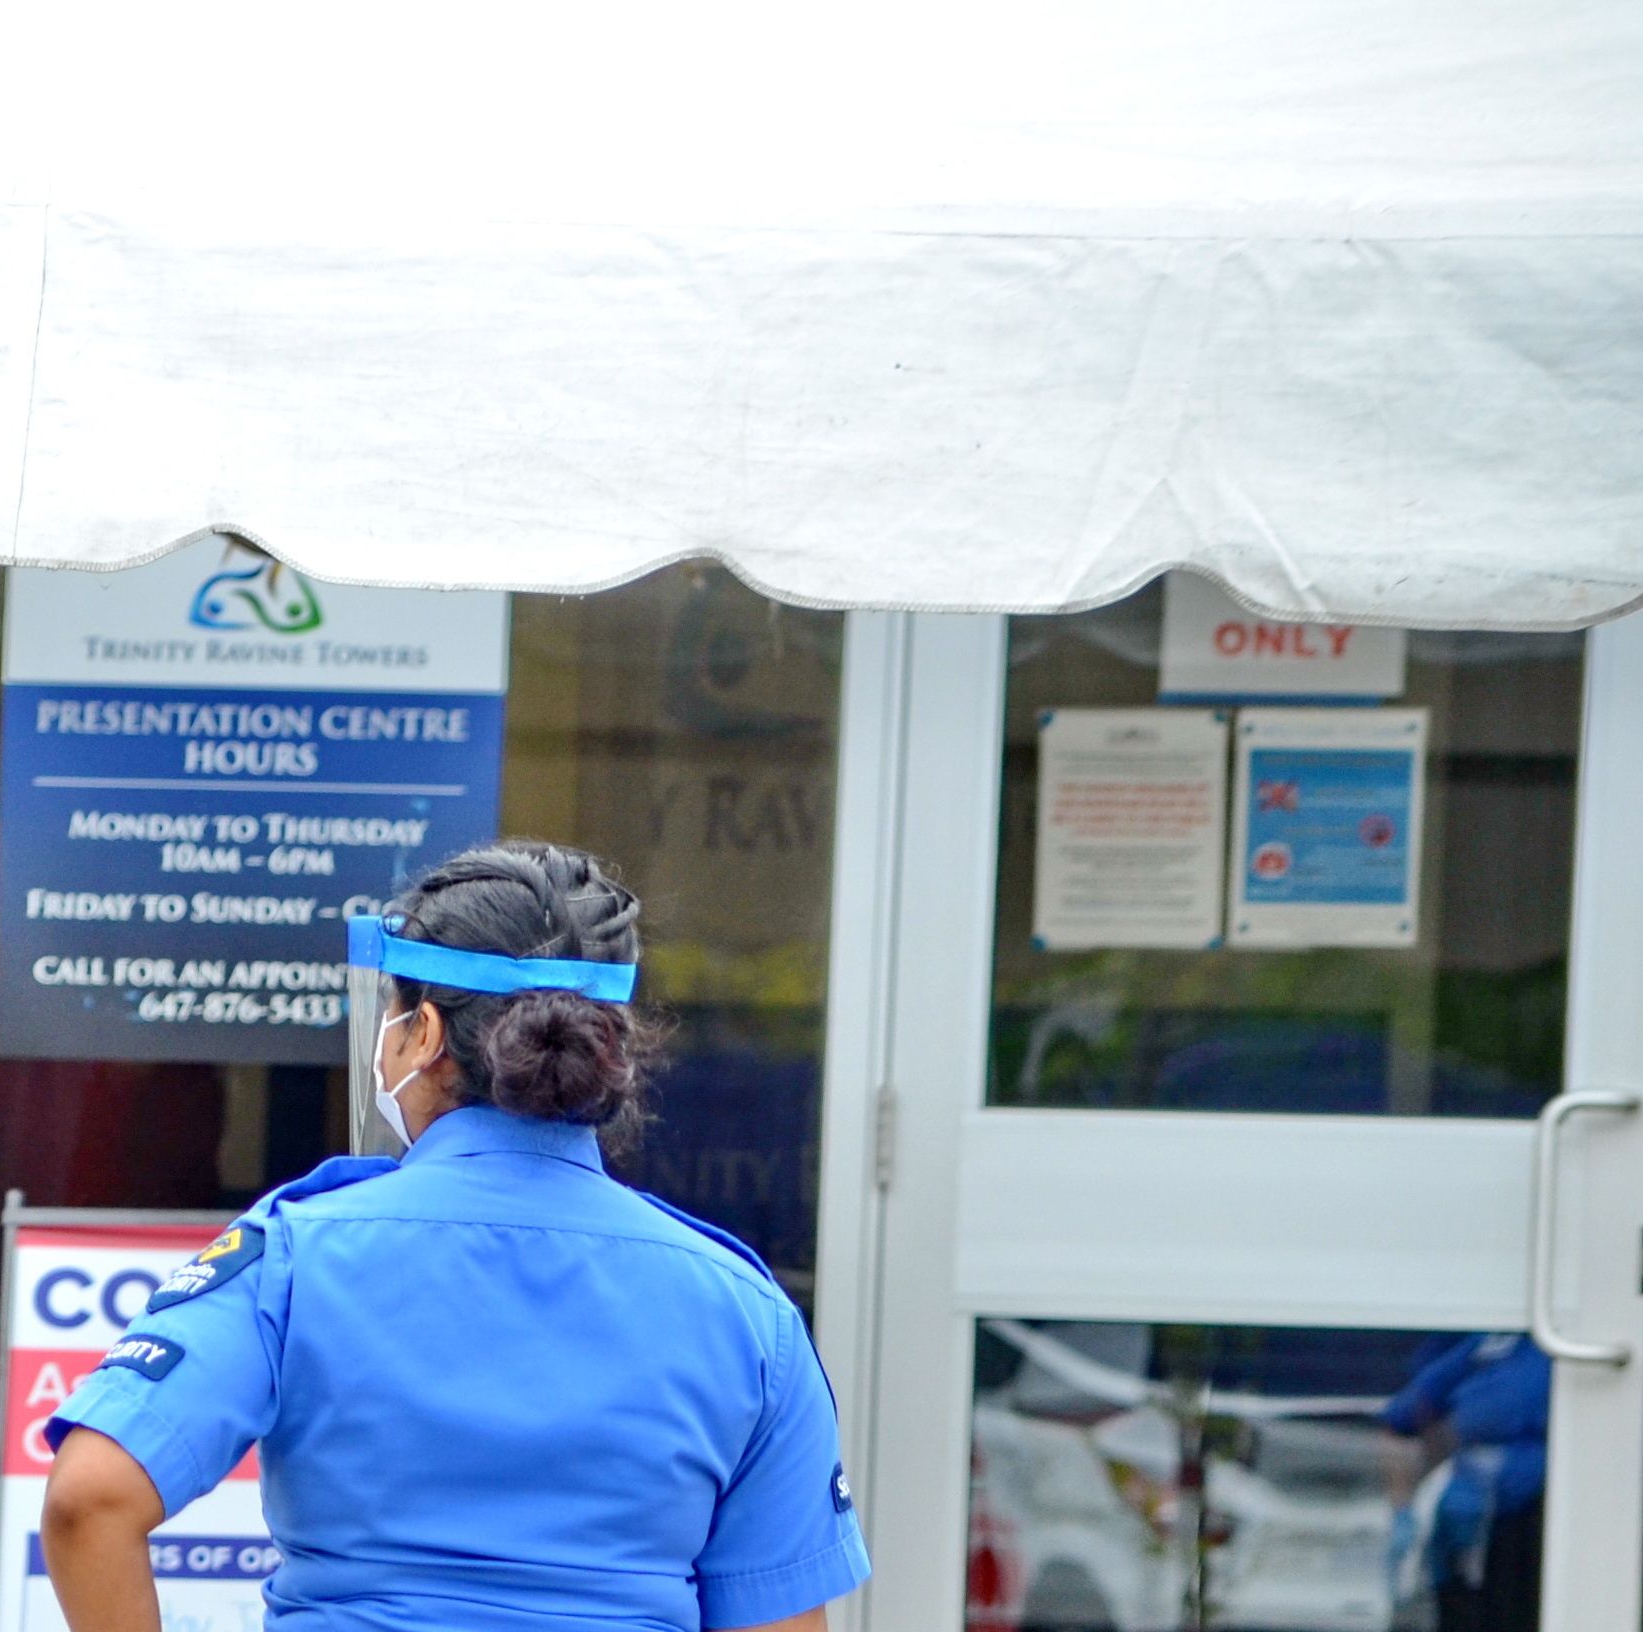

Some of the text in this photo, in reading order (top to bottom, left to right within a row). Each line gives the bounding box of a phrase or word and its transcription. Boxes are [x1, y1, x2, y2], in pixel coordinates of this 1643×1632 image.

[85, 636, 430, 669] TRINITY RAVINE TOWERS
[1213, 622, 1355, 659] ONLY
[36, 700, 470, 742] PRESENTATION CENTRE
[184, 740, 318, 776] HOURS
[68, 810, 428, 846] MONDAY TO THURSDAY
[161, 842, 240, 874] 10AM
[268, 847, 335, 876] 6PM
[26, 888, 135, 920] FRIDAY
[141, 894, 187, 922] TO
[190, 891, 317, 924] SUNDAY
[32, 955, 349, 990] CALL FOR AN APPOIN
[187, 1545, 233, 1573] OF
